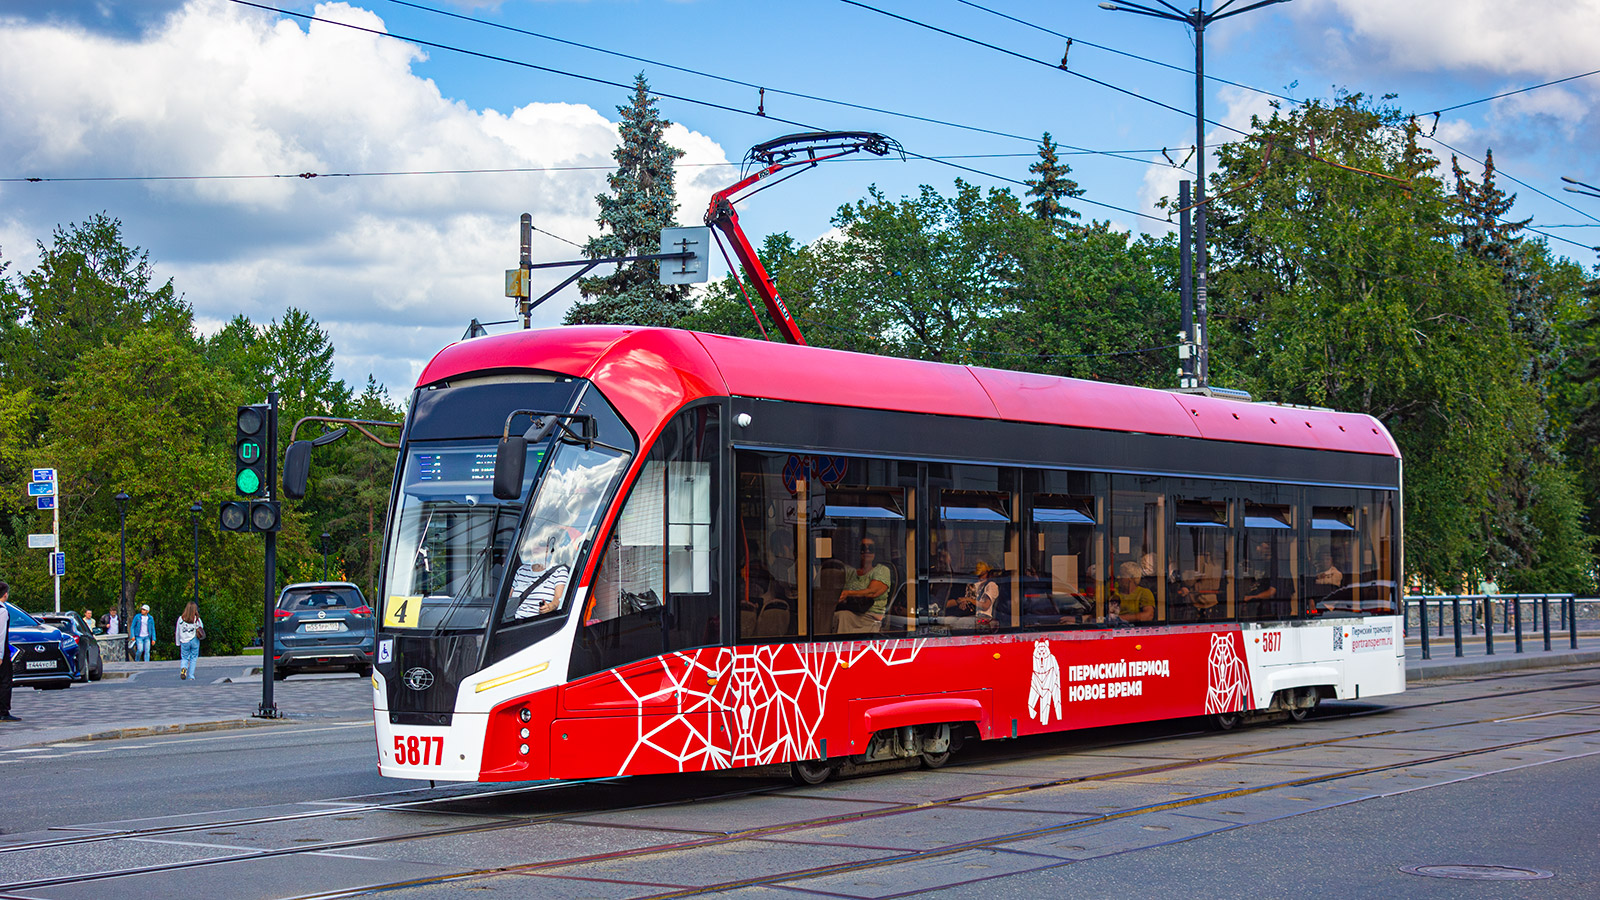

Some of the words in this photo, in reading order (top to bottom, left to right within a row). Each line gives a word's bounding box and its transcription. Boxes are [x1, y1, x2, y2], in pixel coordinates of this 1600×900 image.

[242, 443, 260, 459] 07
[394, 600, 408, 623] 4
[1263, 631, 1281, 653] 5877
[1352, 625, 1372, 637] Пермский
[1352, 637, 1393, 653] gortransperm.ru
[1068, 659, 1127, 682] ПЕРМСКИЙ
[1128, 659, 1170, 677] ПЕРИОД
[1068, 683, 1106, 702] НОВОЕ
[1107, 680, 1142, 698] ВРЕМЯ
[394, 735, 444, 766] 5877
